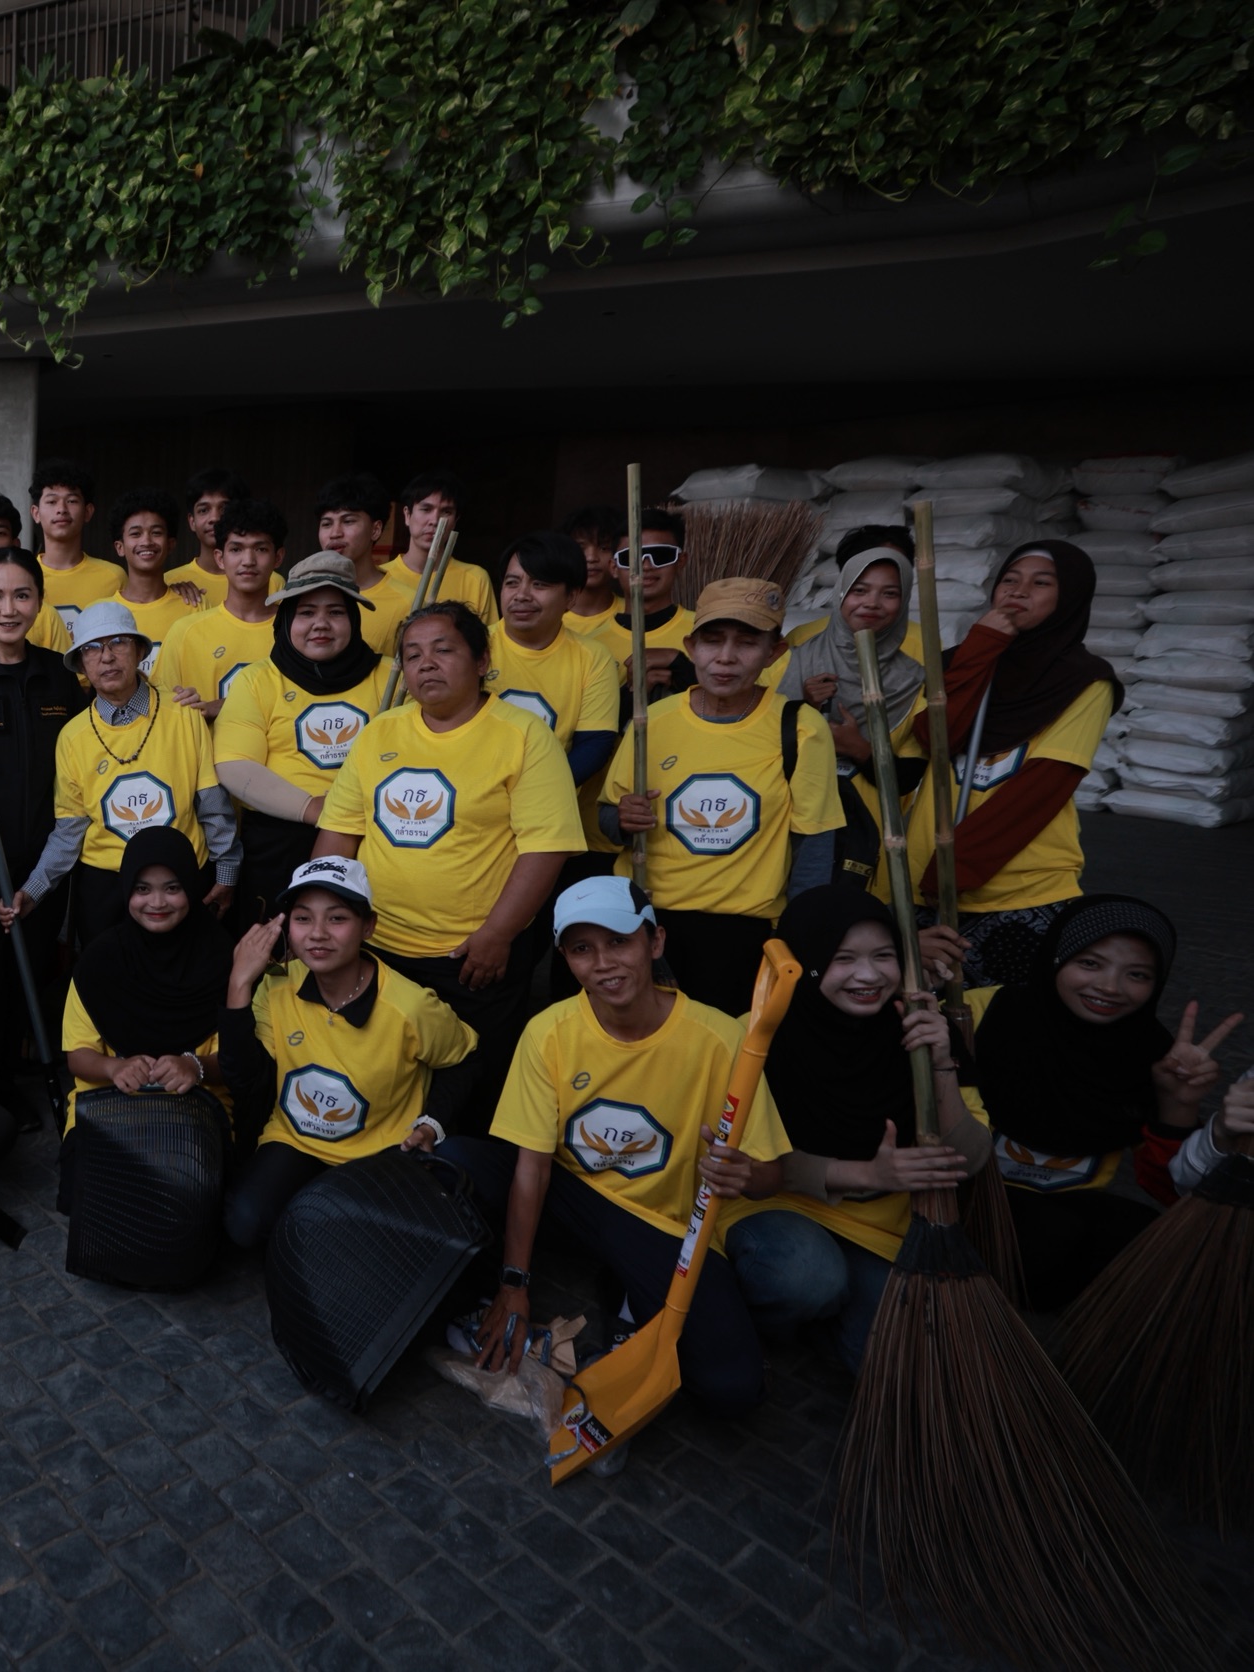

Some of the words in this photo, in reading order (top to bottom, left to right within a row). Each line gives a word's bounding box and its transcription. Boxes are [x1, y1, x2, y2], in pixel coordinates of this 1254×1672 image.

[323, 717, 344, 731] กธ
[127, 793, 148, 807] กธ
[402, 789, 428, 803] กธ
[699, 798, 728, 812] กธ
[395, 825, 429, 837] กล้าธรรม
[694, 833, 732, 844] กล้าธรรม
[313, 1090, 338, 1108] กธ
[604, 1127, 636, 1143] กธ
